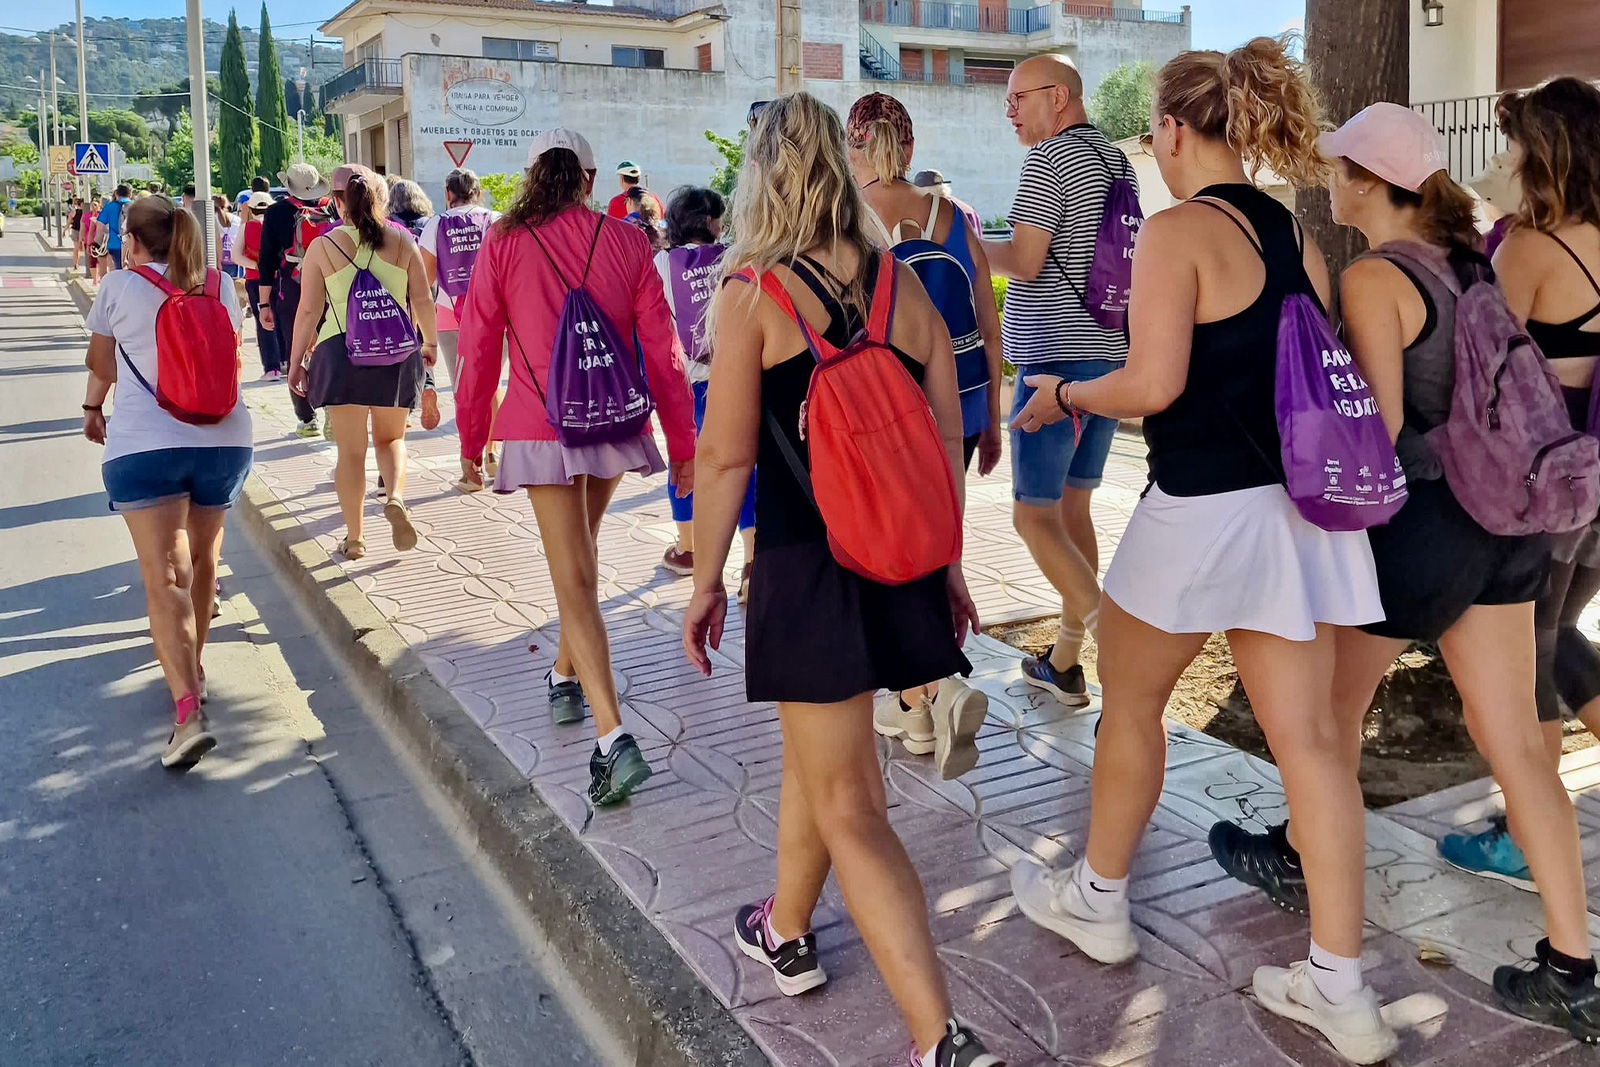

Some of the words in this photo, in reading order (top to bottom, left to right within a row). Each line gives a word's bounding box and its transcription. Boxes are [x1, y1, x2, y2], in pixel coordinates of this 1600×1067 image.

[474, 93, 491, 101] PARA
[493, 94, 519, 102] VENDER
[455, 103, 477, 111] VENGA
[486, 105, 518, 113] COMPRAR
[420, 127, 460, 135] MUEBLES
[470, 128, 505, 136] OBJETOS
[508, 129, 518, 137] DE
[494, 139, 517, 147] VENTA
[451, 236, 468, 245] PER
[468, 234, 480, 242] LA
[361, 300, 379, 309] PER
[380, 298, 394, 308] LA
[358, 308, 399, 321] IGUALTA
